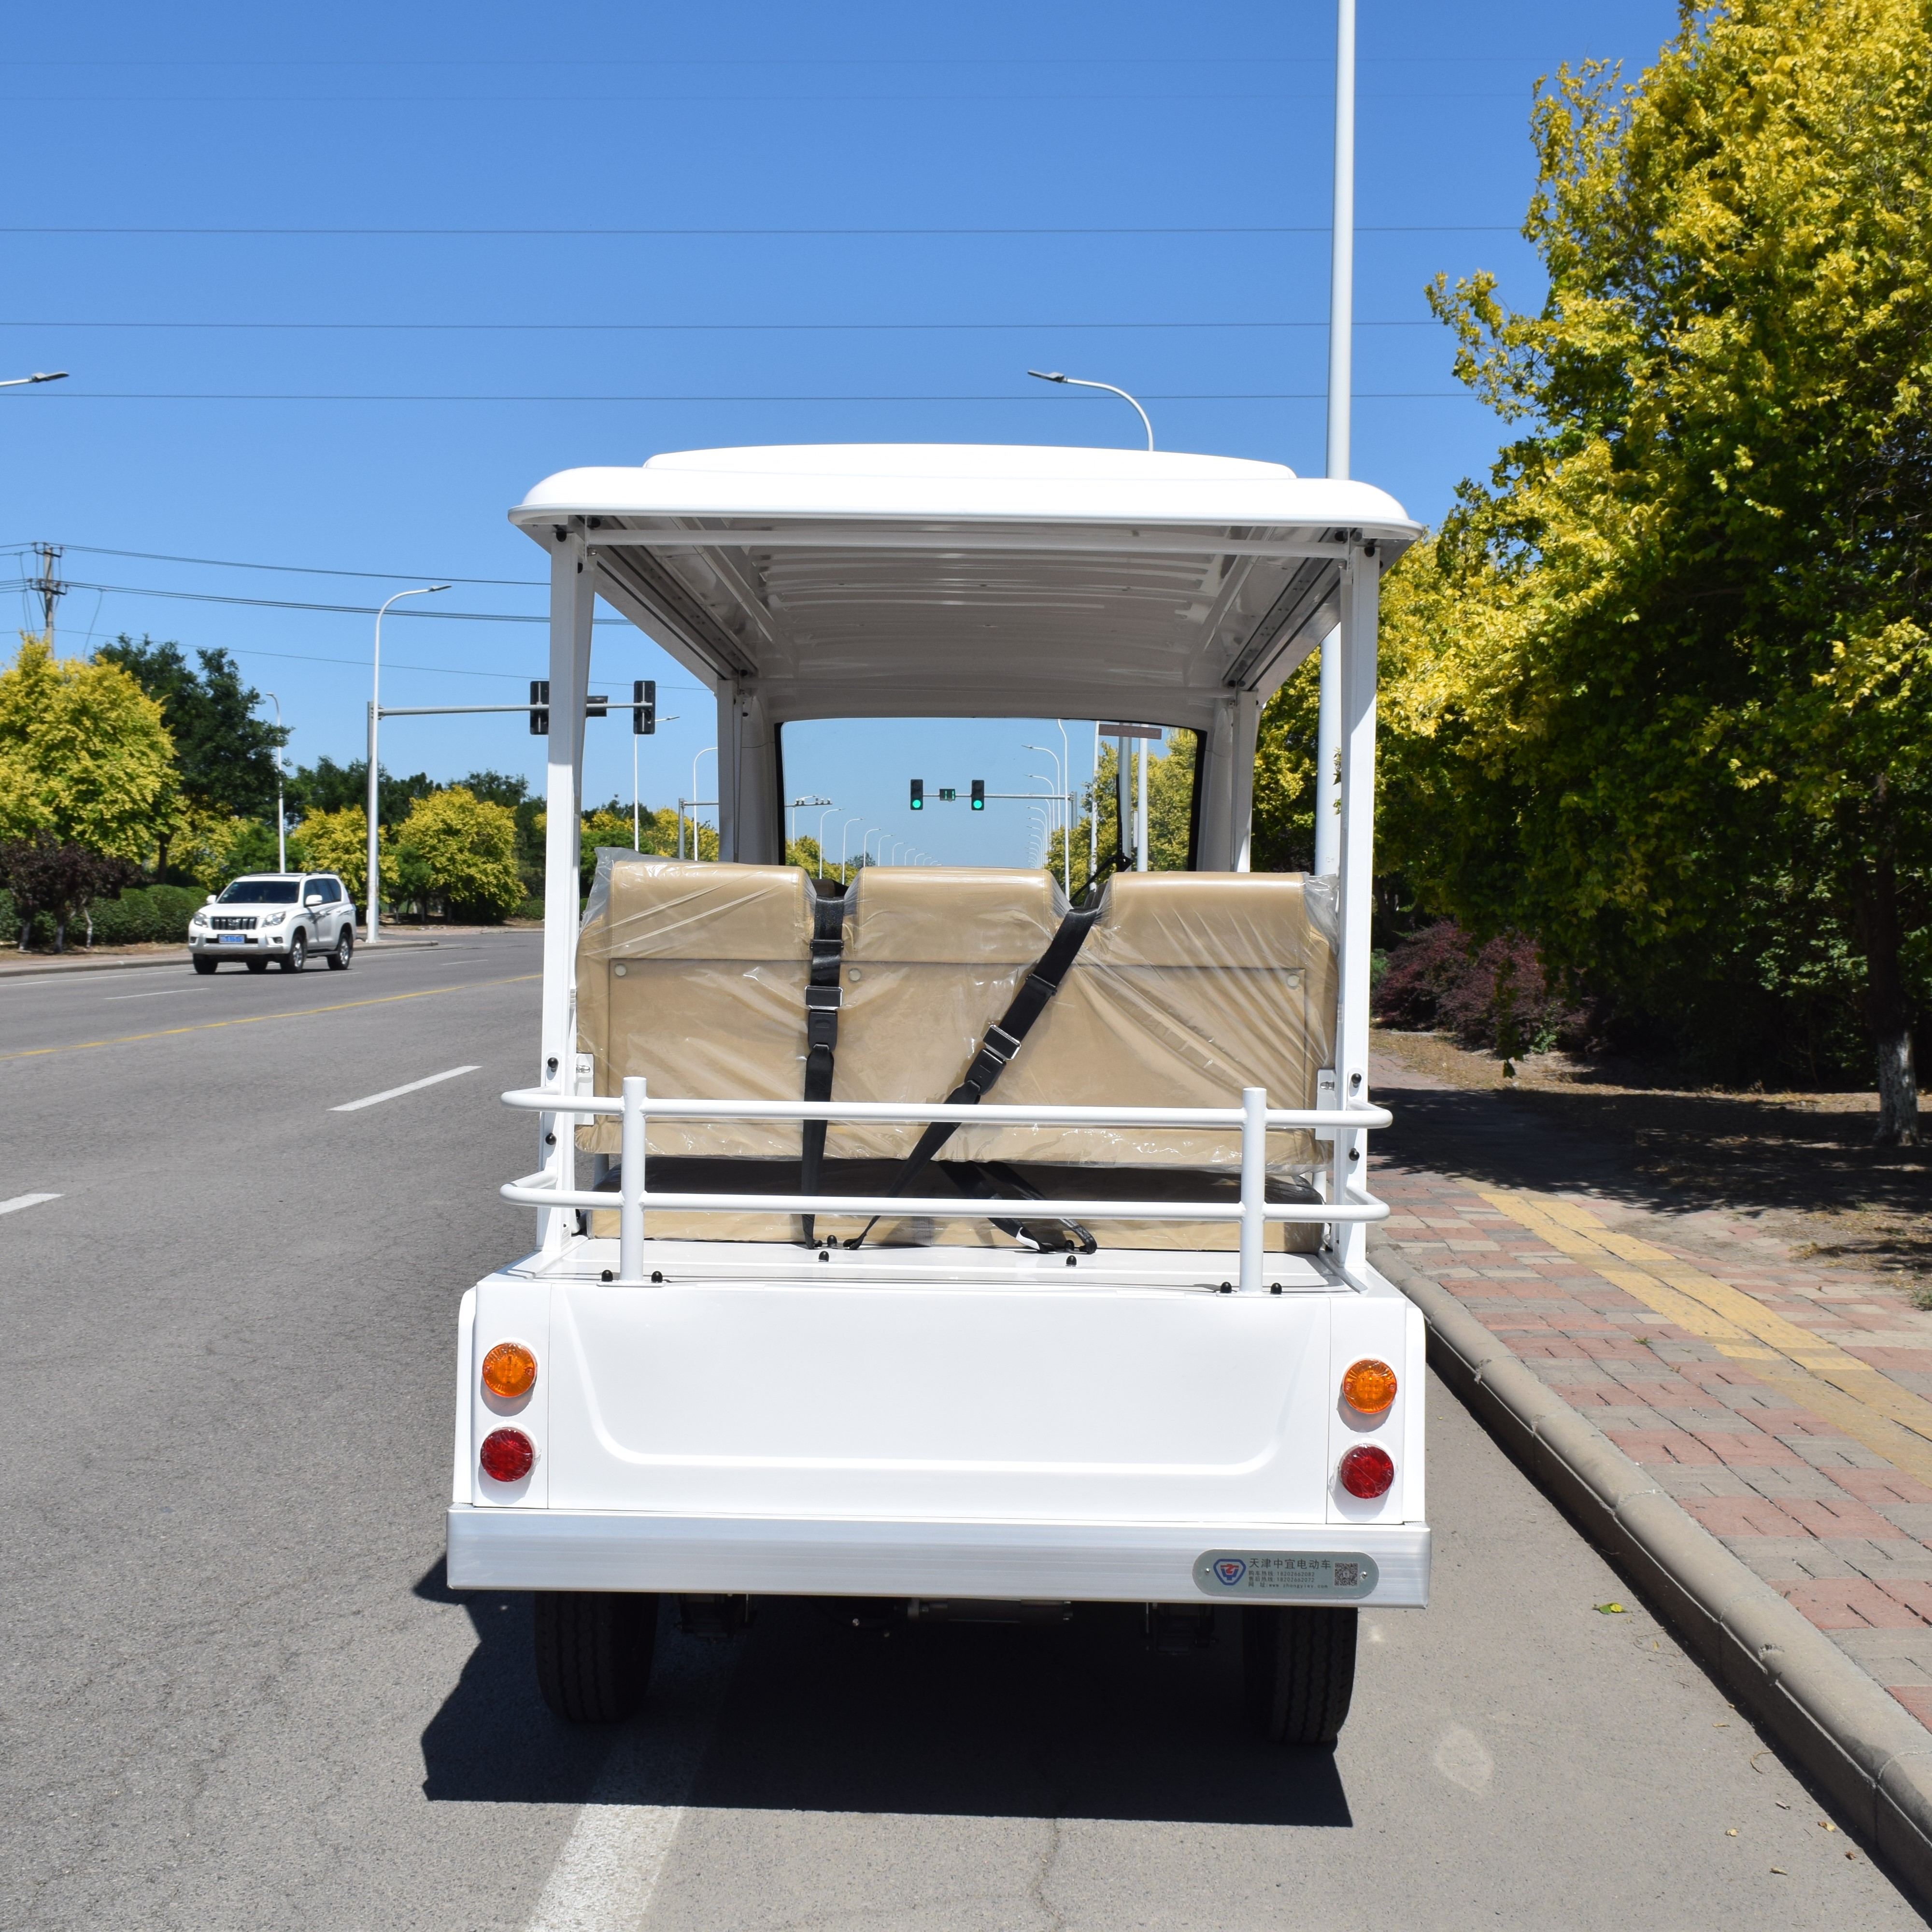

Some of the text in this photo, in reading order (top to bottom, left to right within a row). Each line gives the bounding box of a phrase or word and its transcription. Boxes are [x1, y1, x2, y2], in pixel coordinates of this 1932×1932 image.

[1249, 1558, 1331, 1569] 天津中宜电动车
